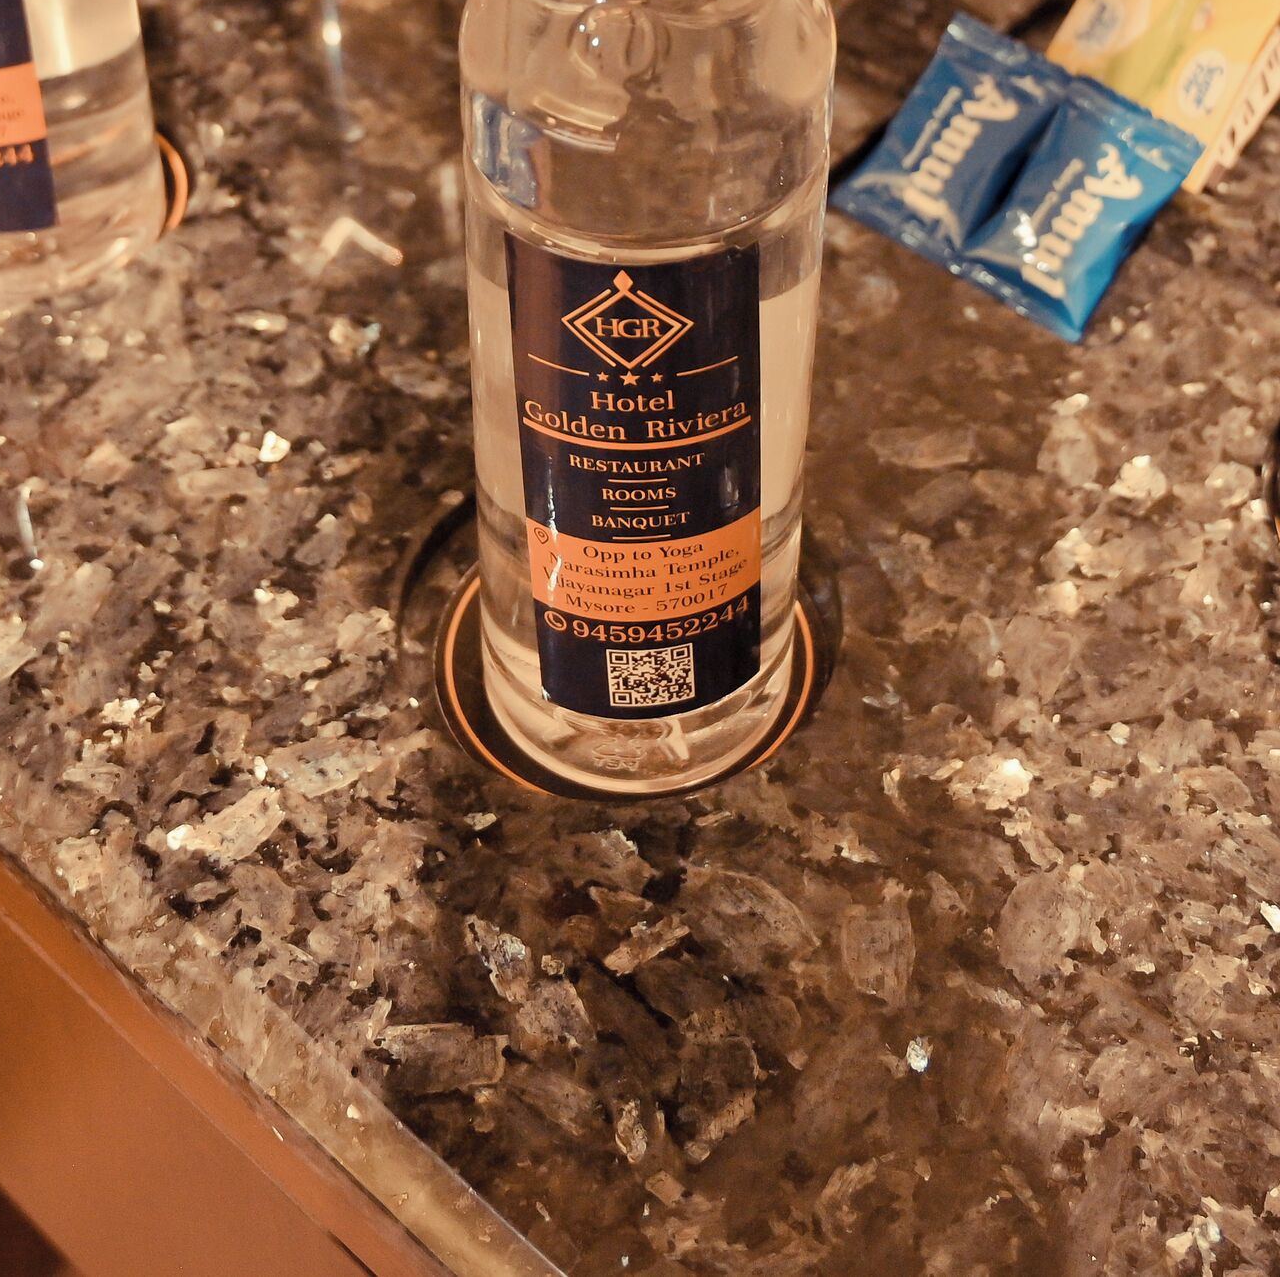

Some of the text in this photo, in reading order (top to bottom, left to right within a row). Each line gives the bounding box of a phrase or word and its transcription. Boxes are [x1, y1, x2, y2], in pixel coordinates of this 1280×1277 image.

[595, 317, 662, 338] HGR
[590, 390, 675, 412] Hotel
[524, 400, 746, 440] Golden Riviera
[569, 453, 705, 473] RESTAURANT
[601, 487, 677, 501] ROOMS
[591, 511, 690, 530] BANQUET
[583, 543, 704, 564] Opp to Yoga
[664, 577, 691, 593] 1st
[699, 559, 748, 585] Stage
[565, 594, 636, 614] Mysore
[656, 584, 728, 612] 570017
[573, 595, 750, 643] 9459452244
